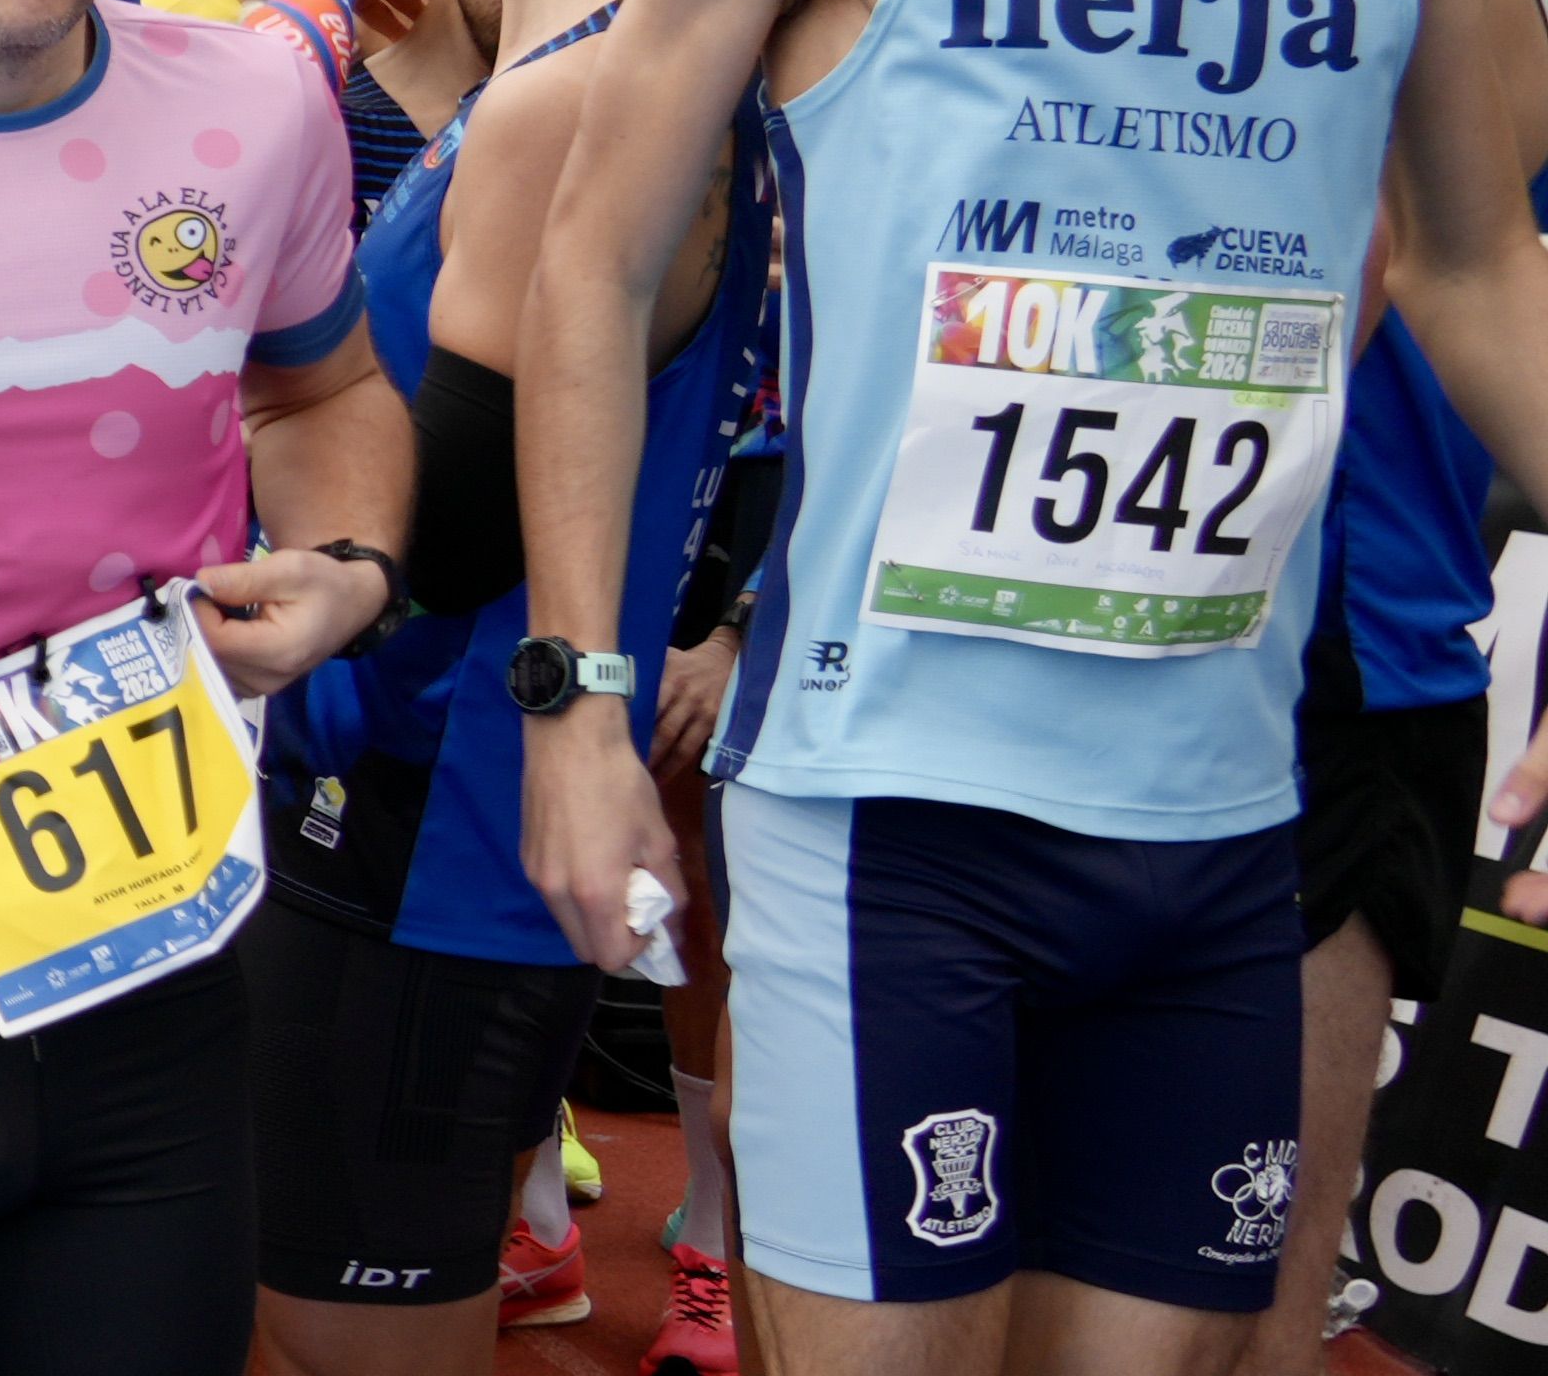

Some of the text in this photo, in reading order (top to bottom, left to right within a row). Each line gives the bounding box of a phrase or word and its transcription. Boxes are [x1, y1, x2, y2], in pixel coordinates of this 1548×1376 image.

[1005, 95, 1297, 164] ATLETISMO
[1055, 206, 1136, 232] metro
[1049, 232, 1144, 267] Málaga
[1219, 226, 1308, 259] CUEVA
[965, 281, 1111, 375] 10K
[1197, 354, 1247, 382] 2026
[970, 401, 1270, 556] 1542
[118, 672, 168, 706] 2026
[92, 863, 183, 907] AITOR HURTADO
[933, 1120, 978, 1137] CLUB
[920, 1206, 992, 1234] ATLETISMO
